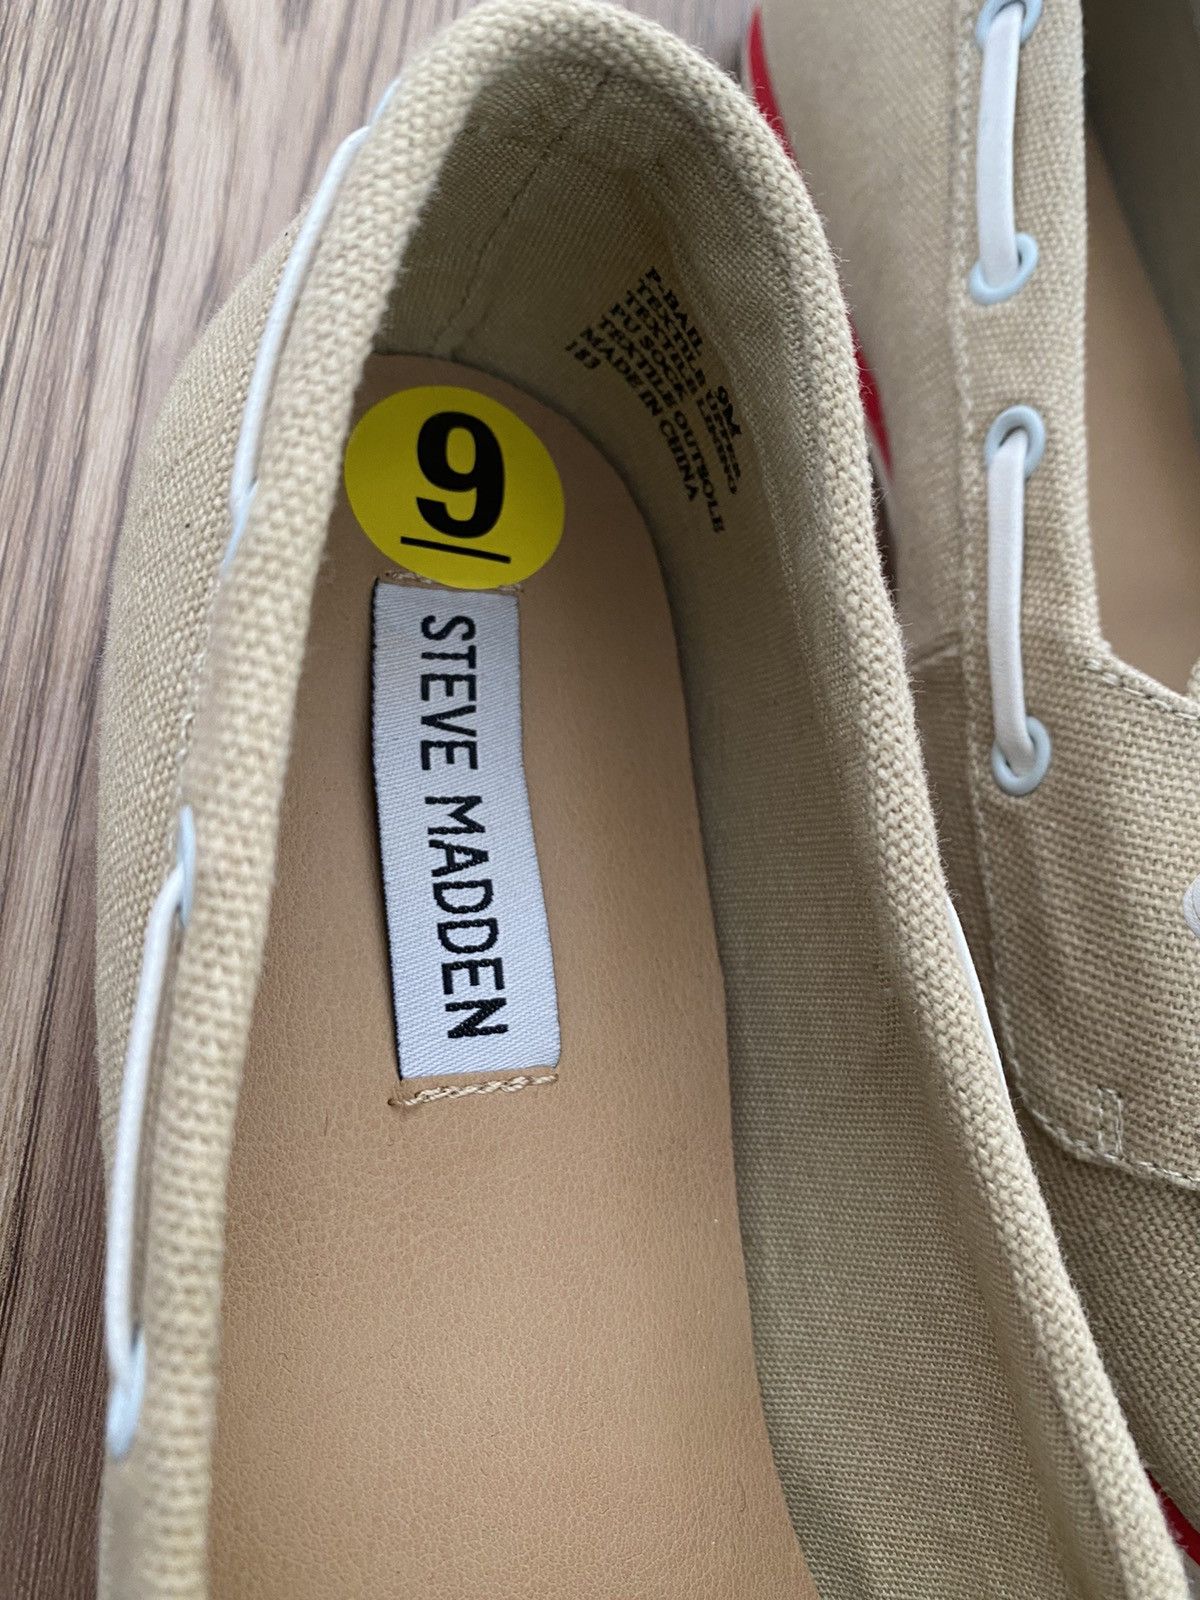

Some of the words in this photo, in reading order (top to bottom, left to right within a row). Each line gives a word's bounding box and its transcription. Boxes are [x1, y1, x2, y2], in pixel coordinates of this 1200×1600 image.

[580, 327, 643, 388] MADE
[638, 389, 663, 417] IN
[659, 419, 698, 501] CHINA
[600, 315, 679, 408] TEXTILE
[674, 411, 725, 532] OUTSOLE
[611, 303, 641, 333] PU
[640, 335, 688, 402] SOCK
[626, 290, 698, 394] TEXTILE
[696, 397, 738, 494] LINING
[637, 277, 706, 387] TEXTILE
[706, 389, 741, 480] UPPER
[717, 386, 742, 436] 9M
[416, 410, 506, 539] 9
[420, 615, 477, 770] STEVE
[424, 795, 508, 1039] MADDEN
